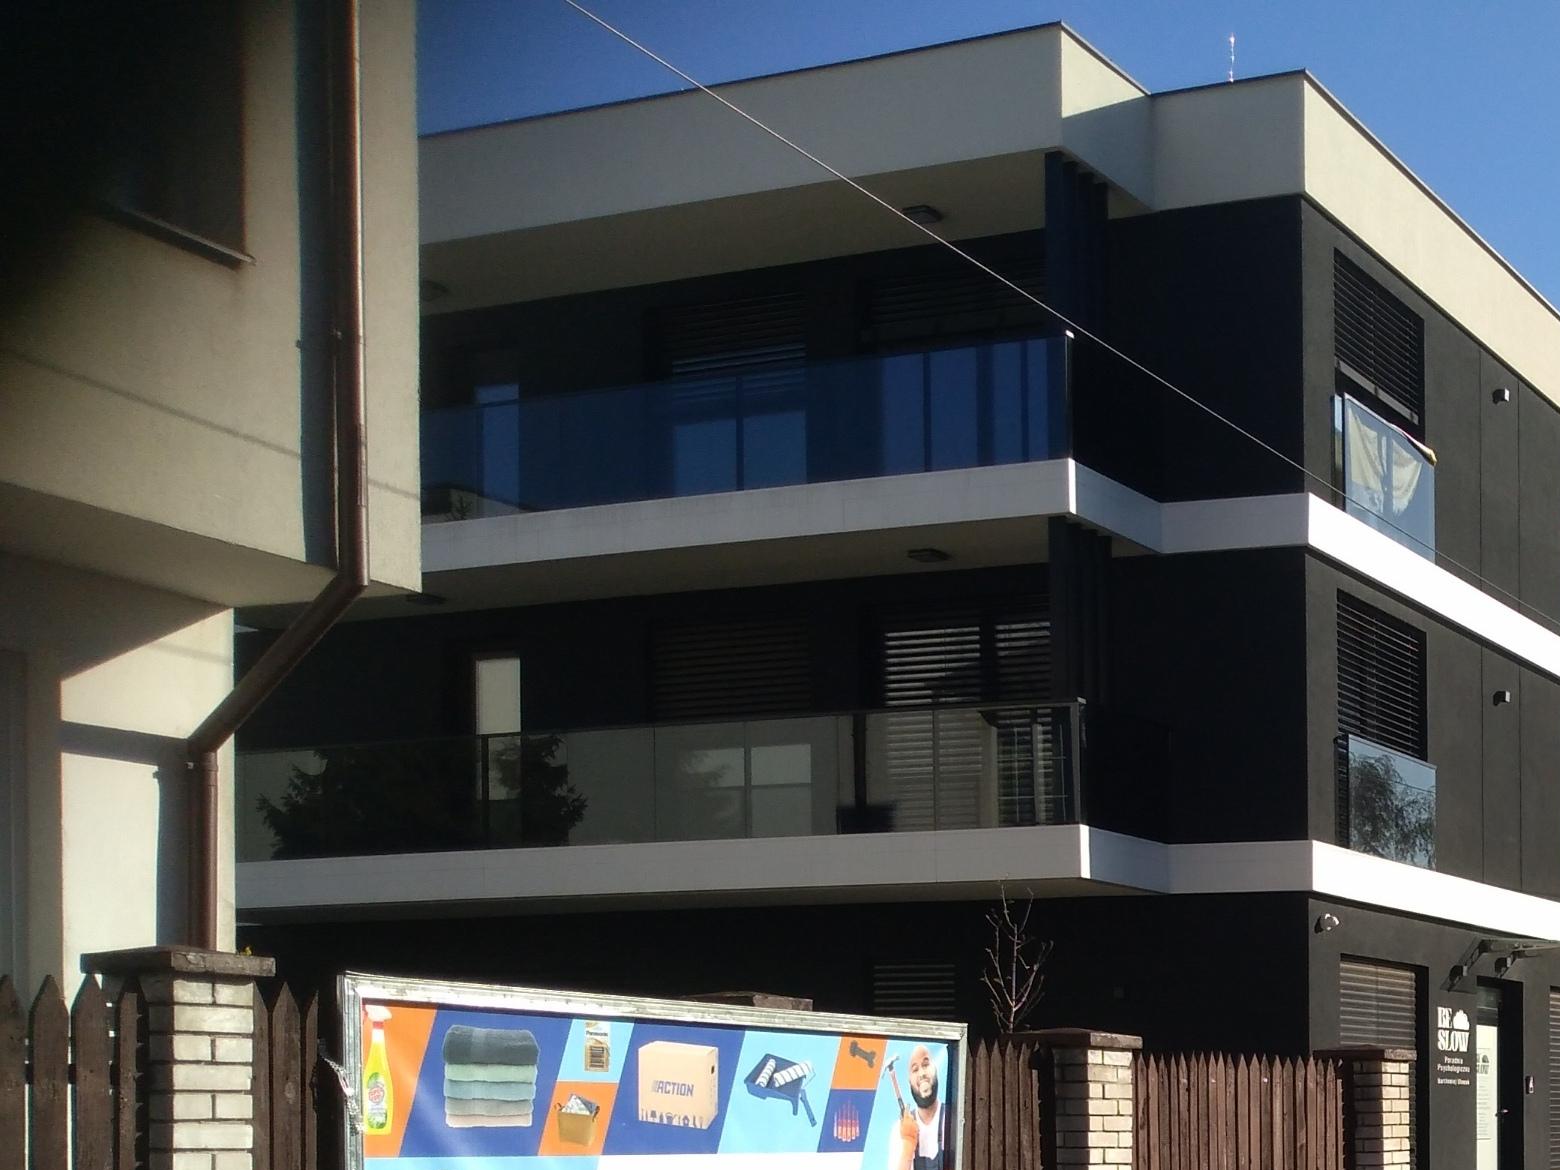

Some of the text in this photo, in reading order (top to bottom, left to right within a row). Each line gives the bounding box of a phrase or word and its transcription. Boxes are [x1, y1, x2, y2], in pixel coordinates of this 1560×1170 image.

[1437, 1007, 1452, 1028] BE
[1437, 1029, 1470, 1052] SLOW
[656, 1080, 694, 1097] ACTION
